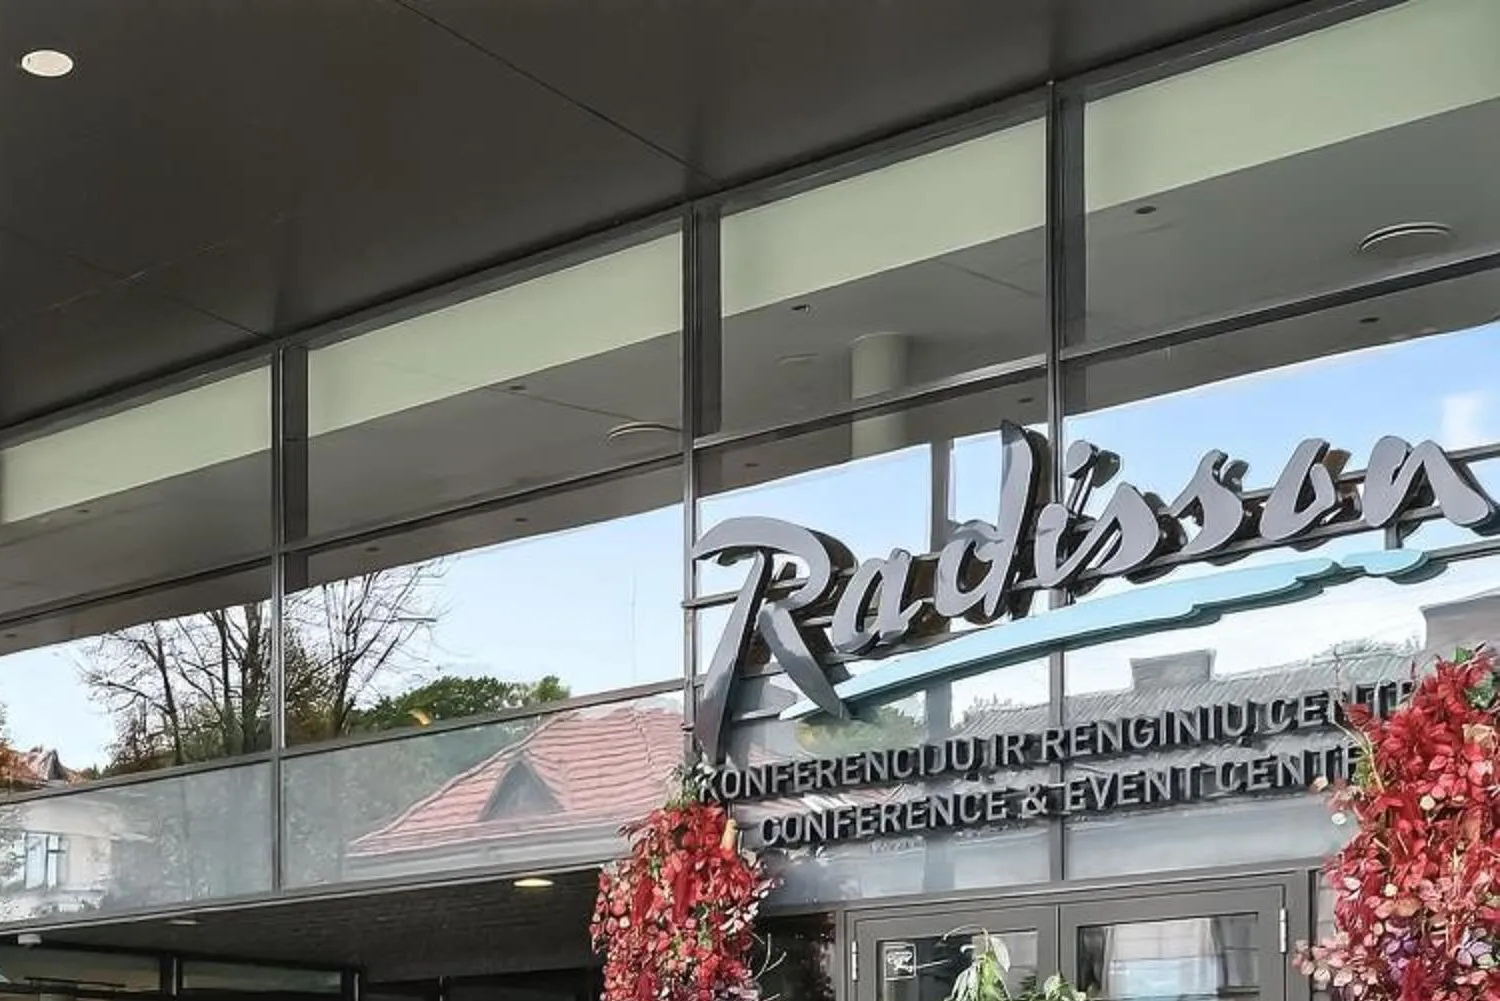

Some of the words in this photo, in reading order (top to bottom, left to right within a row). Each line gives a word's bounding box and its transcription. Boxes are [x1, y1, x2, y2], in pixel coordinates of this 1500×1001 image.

[693, 419, 1494, 764] Radisson
[989, 732, 1027, 768] IR
[759, 790, 1008, 846] CONFERENCE
[1021, 784, 1049, 818] &
[1065, 762, 1201, 812] EVENT
